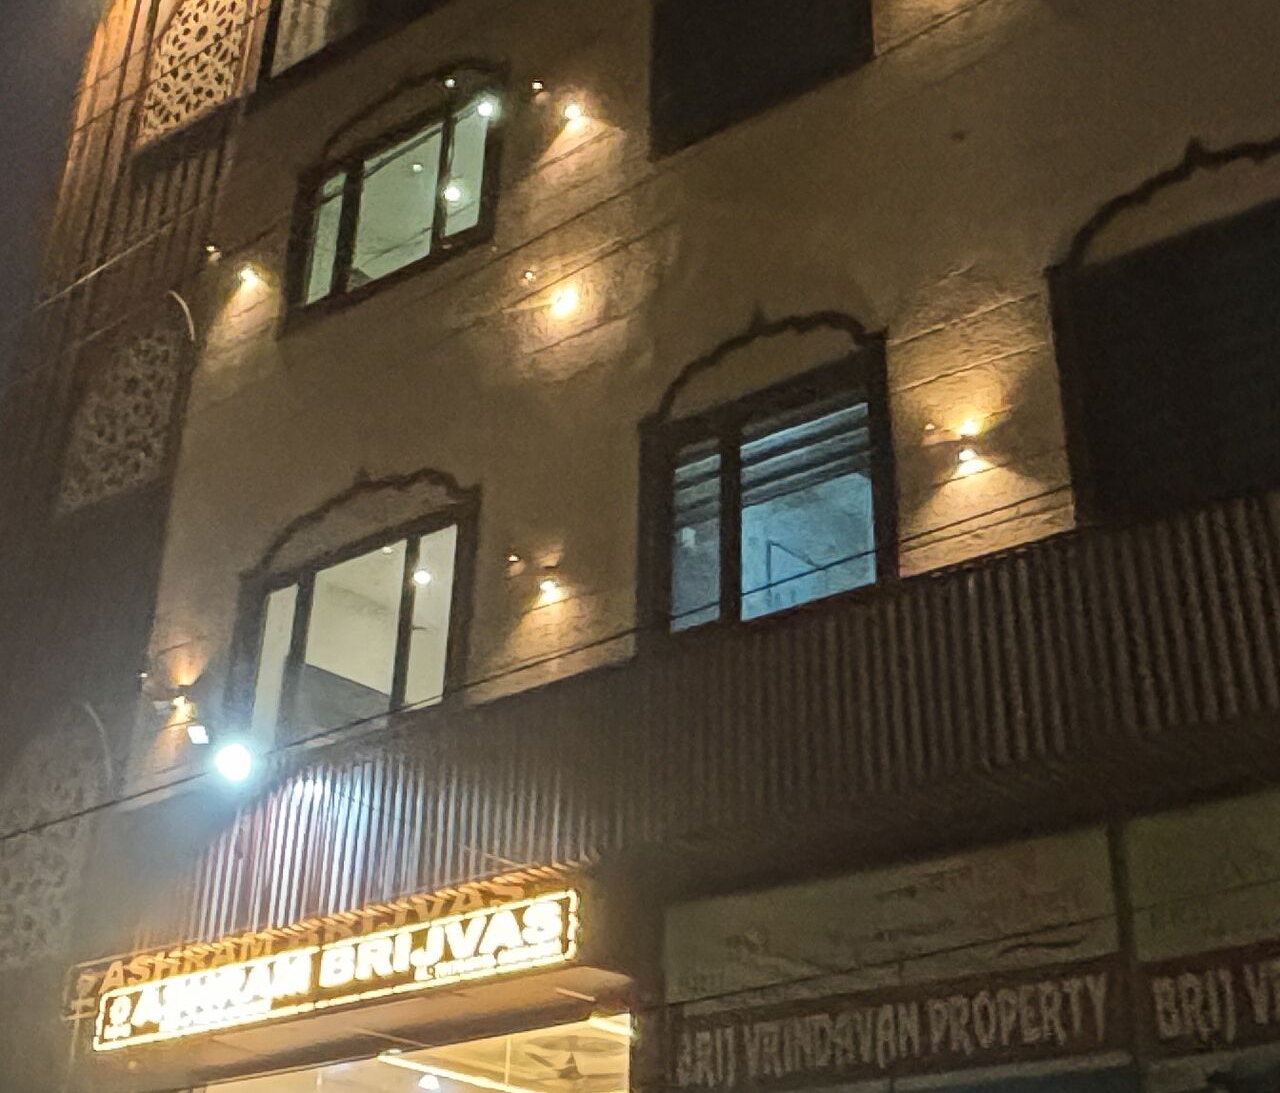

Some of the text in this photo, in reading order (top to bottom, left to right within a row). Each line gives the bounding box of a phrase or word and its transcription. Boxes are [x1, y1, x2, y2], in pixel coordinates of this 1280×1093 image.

[319, 900, 562, 988] BRIJVAS
[743, 1001, 920, 1079] VRINDAVAN
[927, 972, 1109, 1055] PROPERTY
[1152, 969, 1236, 1045] BRIJ
